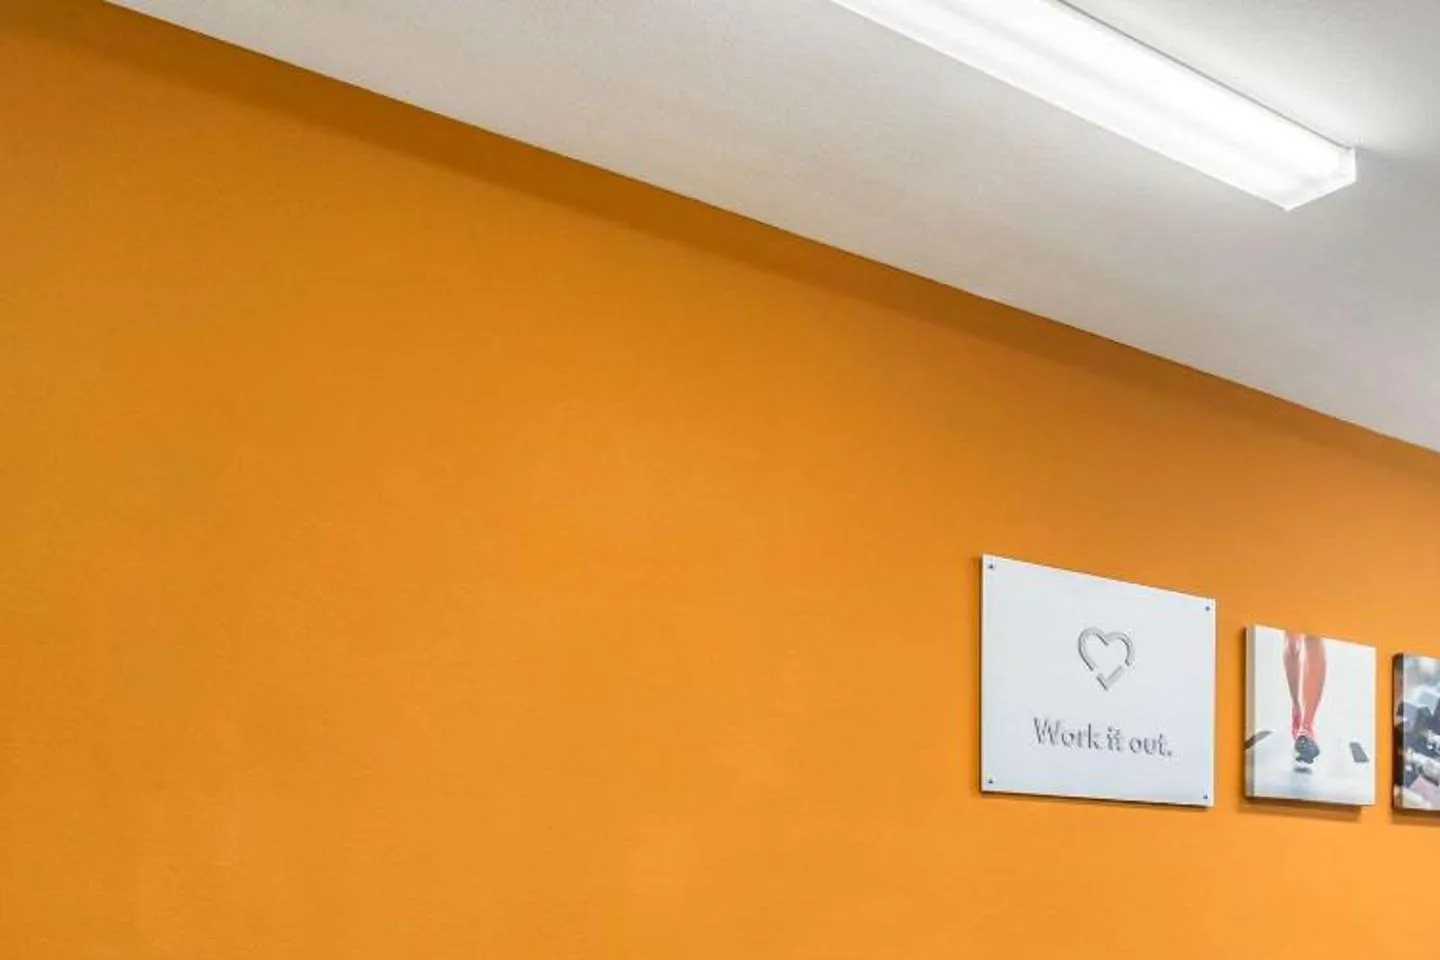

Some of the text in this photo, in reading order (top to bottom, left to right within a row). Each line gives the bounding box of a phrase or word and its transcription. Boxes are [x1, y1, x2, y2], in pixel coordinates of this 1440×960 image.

[1033, 717, 1172, 757] Work it out.
